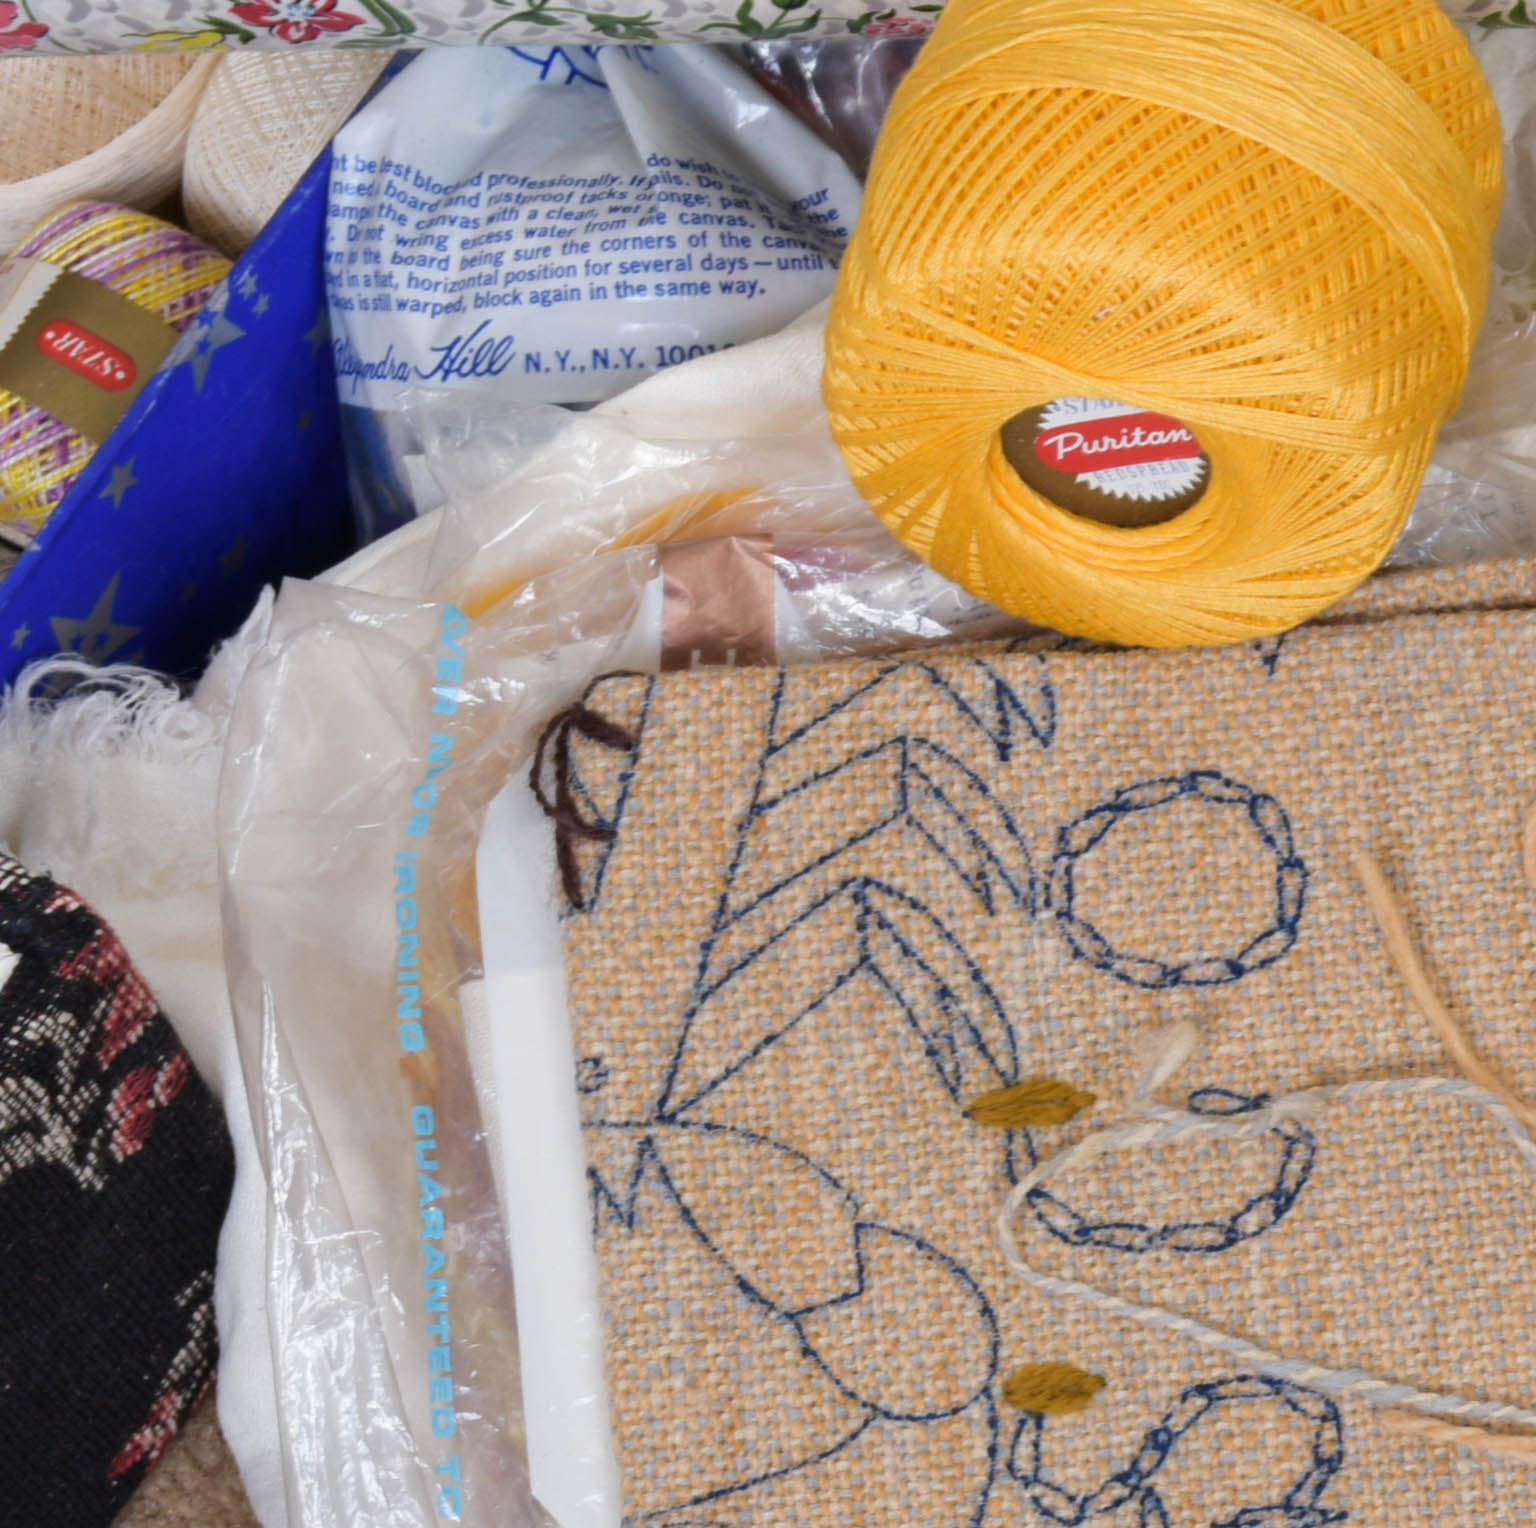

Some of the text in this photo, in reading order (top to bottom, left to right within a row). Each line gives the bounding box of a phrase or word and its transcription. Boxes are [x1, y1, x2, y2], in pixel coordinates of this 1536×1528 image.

[486, 171, 625, 191] professionally.
[647, 152, 672, 168] do
[378, 202, 408, 227] the
[415, 214, 480, 231] canvas
[486, 207, 520, 226] with
[527, 208, 539, 221] a
[545, 207, 599, 221] clean,
[384, 180, 439, 213] board
[580, 187, 629, 205] tacks
[390, 250, 450, 272] board
[460, 249, 505, 271] being
[512, 245, 552, 262] sure
[561, 239, 592, 256] the
[600, 233, 678, 252] corners
[687, 230, 708, 248] of
[719, 230, 753, 249] the
[395, 233, 449, 252] wring
[460, 229, 514, 250] excess
[524, 225, 577, 239] water
[583, 219, 627, 235] from
[677, 210, 756, 229] canvas.
[406, 268, 499, 294] horizontal
[503, 262, 578, 289] position
[583, 258, 613, 277] for
[618, 252, 693, 275] several
[700, 252, 750, 276] days
[776, 254, 824, 272] until
[395, 294, 468, 319] warped,
[472, 287, 523, 309] block
[529, 284, 582, 308] again
[588, 281, 608, 301] in
[614, 279, 647, 299] the
[654, 280, 712, 297] same
[719, 279, 767, 299] way.
[51, 331, 122, 378] STAR
[413, 318, 517, 382] Hill
[591, 347, 645, 371] N.Y.
[1042, 426, 1194, 461] Puritan
[394, 850, 427, 1054] IRONING
[410, 1104, 458, 1438] GUARANTEED
[434, 1452, 463, 1521] TO
